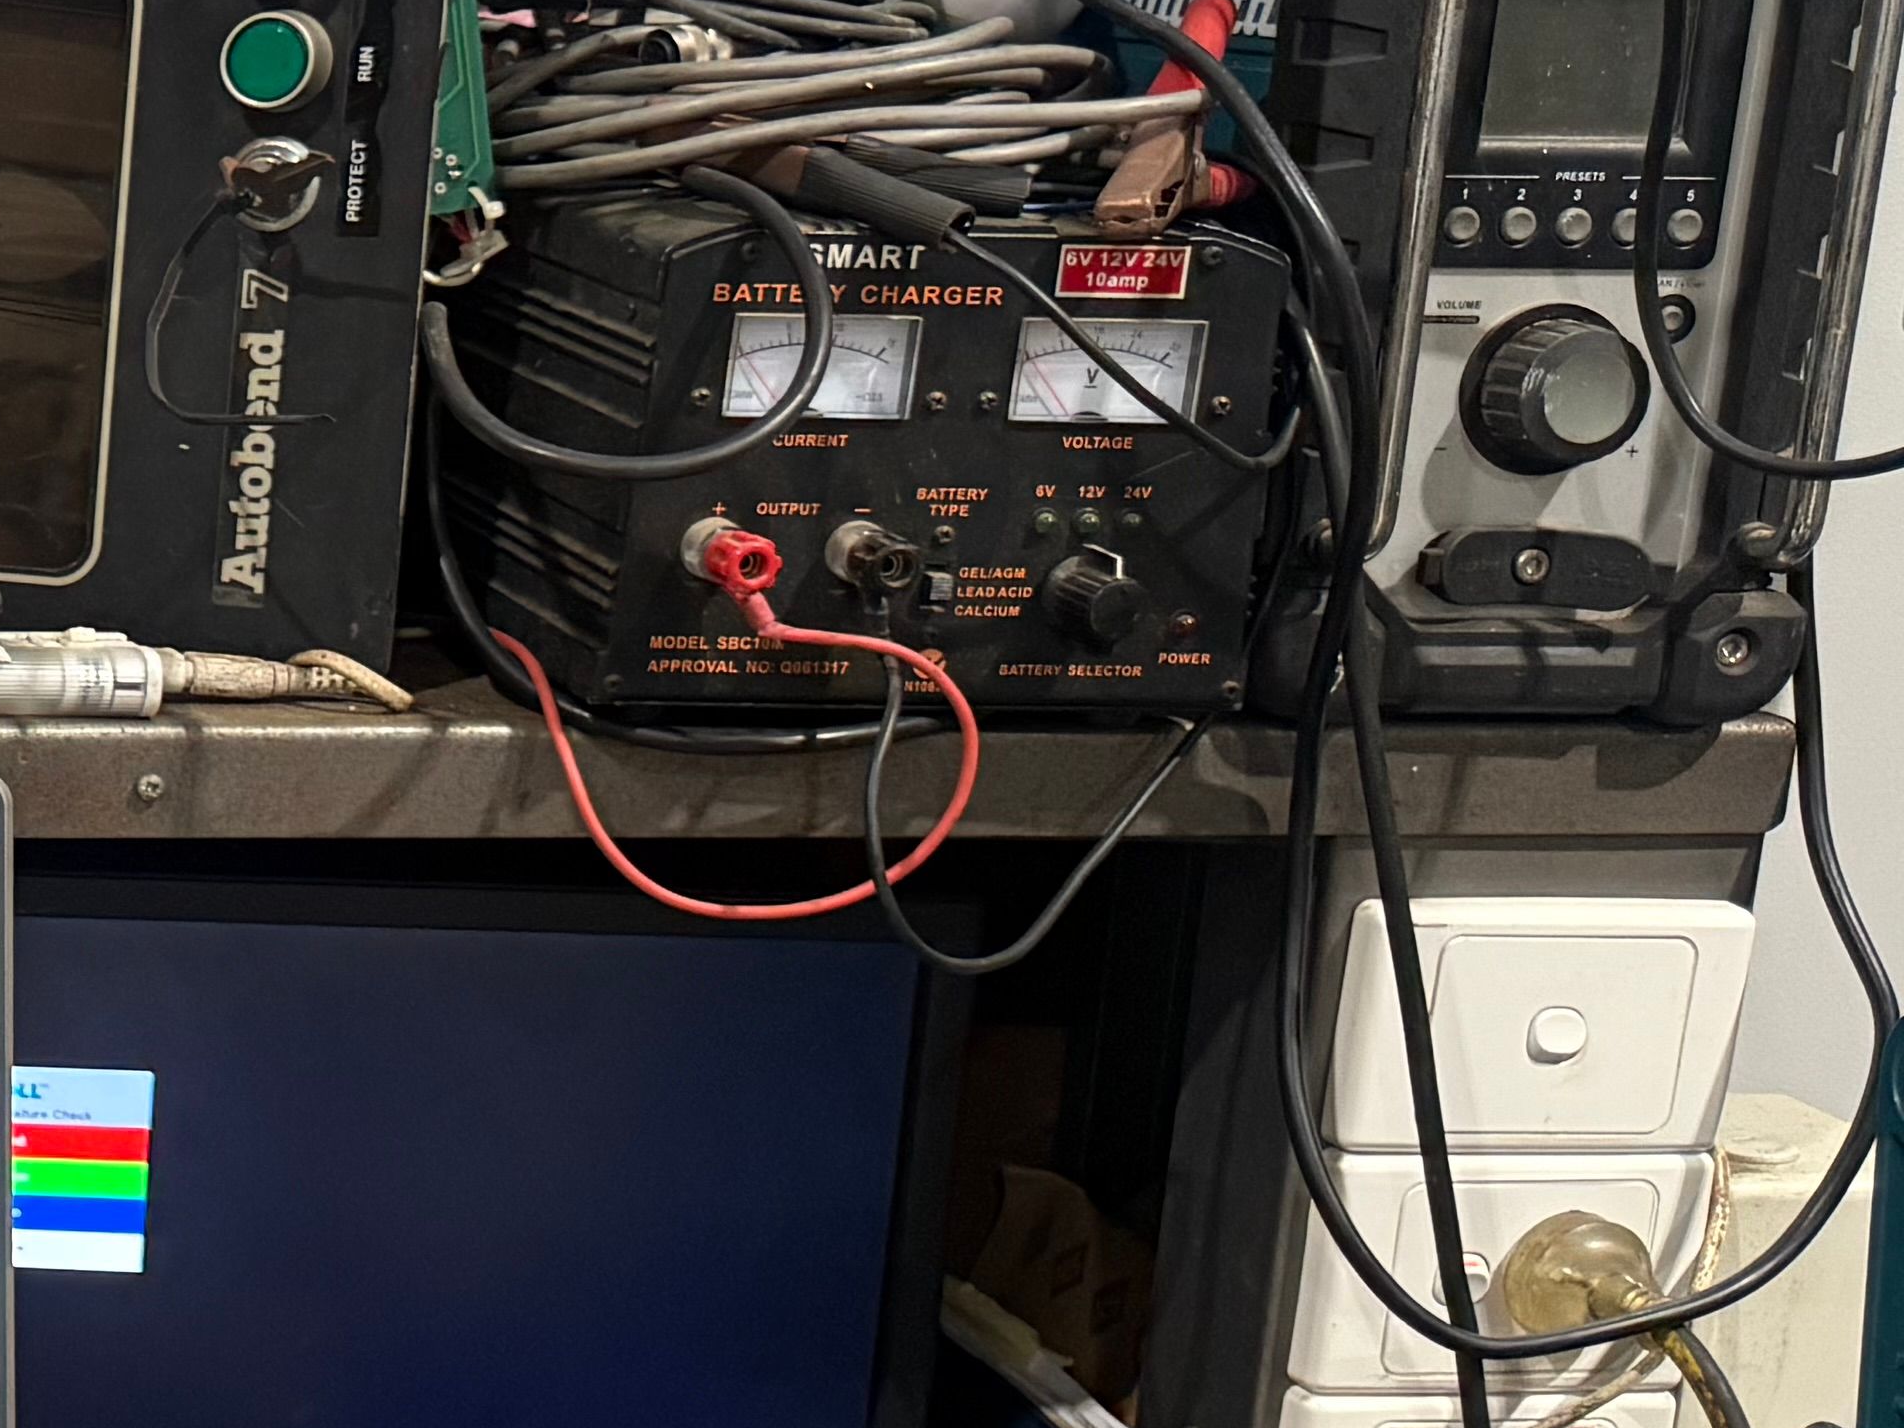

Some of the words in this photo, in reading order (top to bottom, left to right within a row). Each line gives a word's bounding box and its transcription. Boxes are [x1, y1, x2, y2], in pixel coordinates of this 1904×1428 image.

[359, 46, 373, 82] RUN
[346, 140, 365, 223] PROTECT
[1556, 172, 1606, 181] PRESETS
[1066, 251, 1095, 270] 6V
[1099, 251, 1141, 270] 12V
[1144, 251, 1184, 271] 24V
[1086, 271, 1149, 291] 10amp
[712, 282, 846, 304] BATTEY
[861, 284, 1003, 307] CHARGER
[773, 433, 848, 449] CURRENT
[1063, 435, 1133, 450] VOLTAGE
[917, 487, 989, 502] BATTERY
[757, 502, 821, 517] OUTPUT
[930, 504, 969, 517] TYPE
[954, 604, 1021, 617] CALCIUM
[1158, 652, 1210, 665] POWER
[999, 664, 1061, 676] BATTERY
[1068, 665, 1142, 677] SELECTOR
